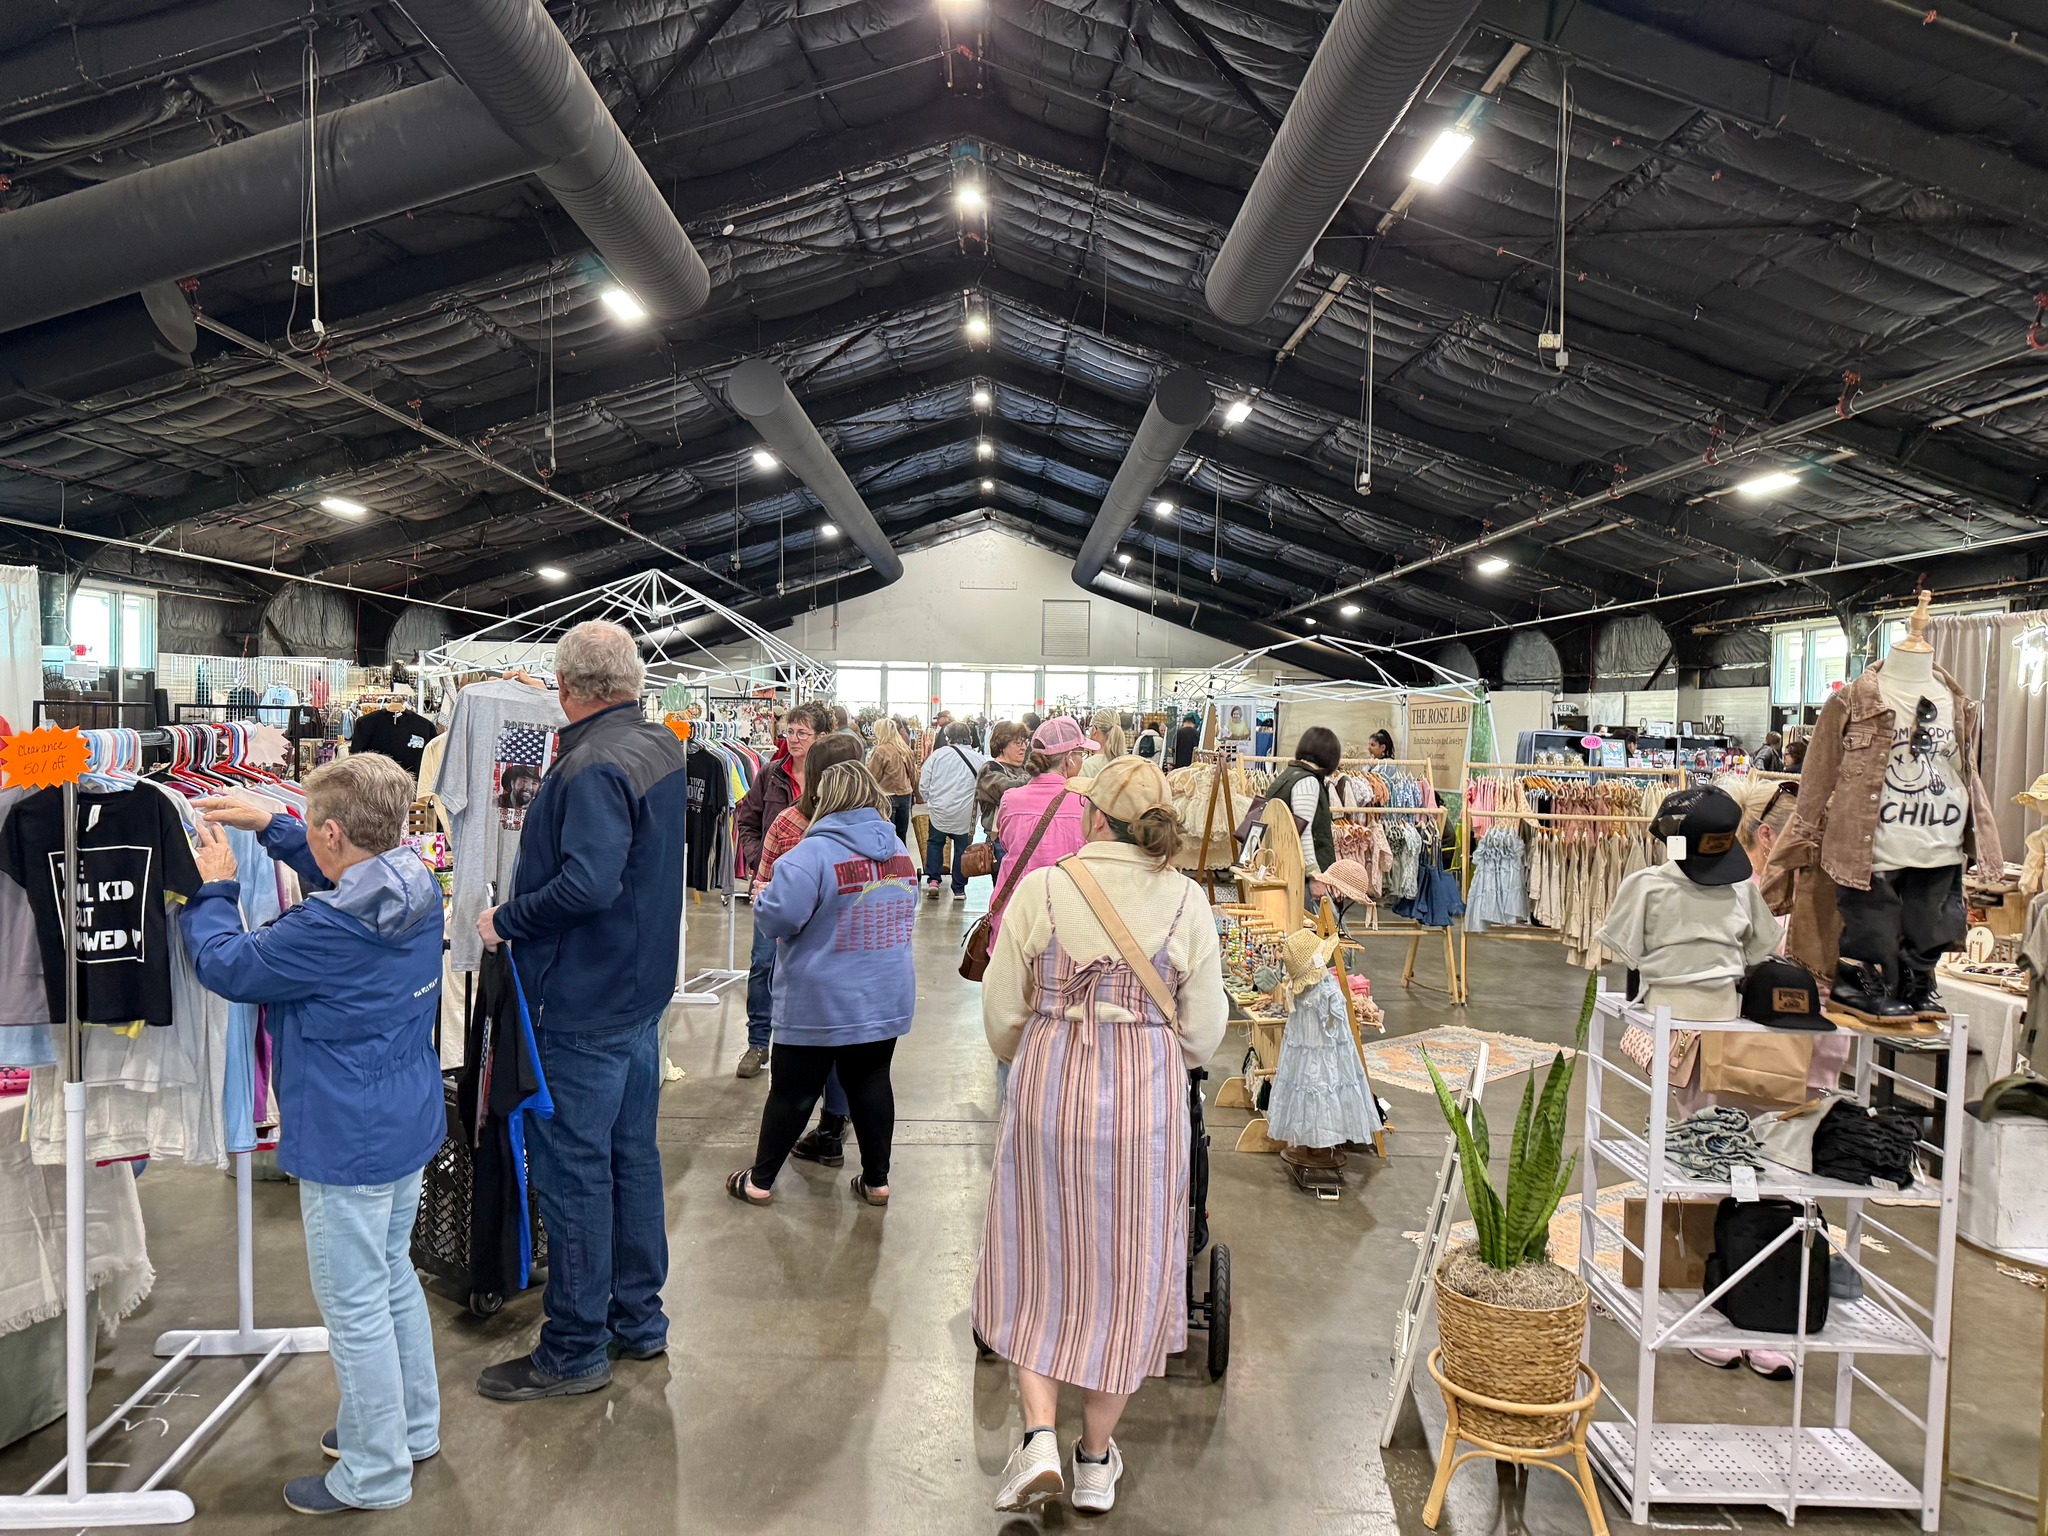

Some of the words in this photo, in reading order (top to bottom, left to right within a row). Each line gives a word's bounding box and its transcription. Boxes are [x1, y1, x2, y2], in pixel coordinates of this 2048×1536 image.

[1411, 708, 1427, 725] THE
[1428, 707, 1449, 724] ROSE
[1450, 706, 1467, 723] LAB
[18, 741, 67, 757] Clearance
[52, 755, 68, 770] off
[687, 785, 704, 801] ONG
[1880, 801, 1960, 827] CHILD
[99, 881, 134, 901] KID
